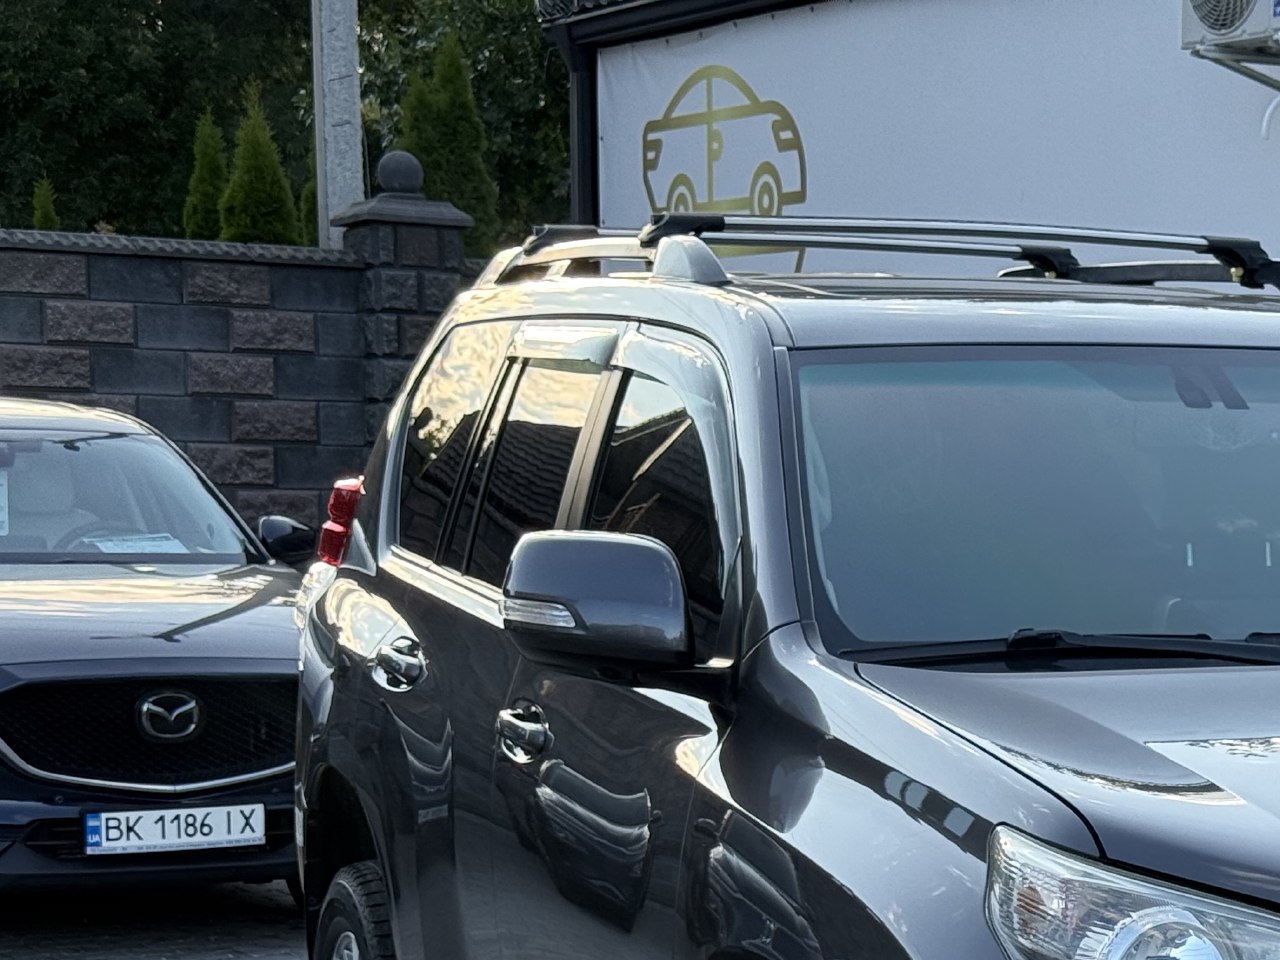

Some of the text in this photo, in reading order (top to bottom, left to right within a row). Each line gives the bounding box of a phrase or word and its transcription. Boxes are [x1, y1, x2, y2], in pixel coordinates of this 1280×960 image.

[105, 808, 256, 842] BK 1186 IX
